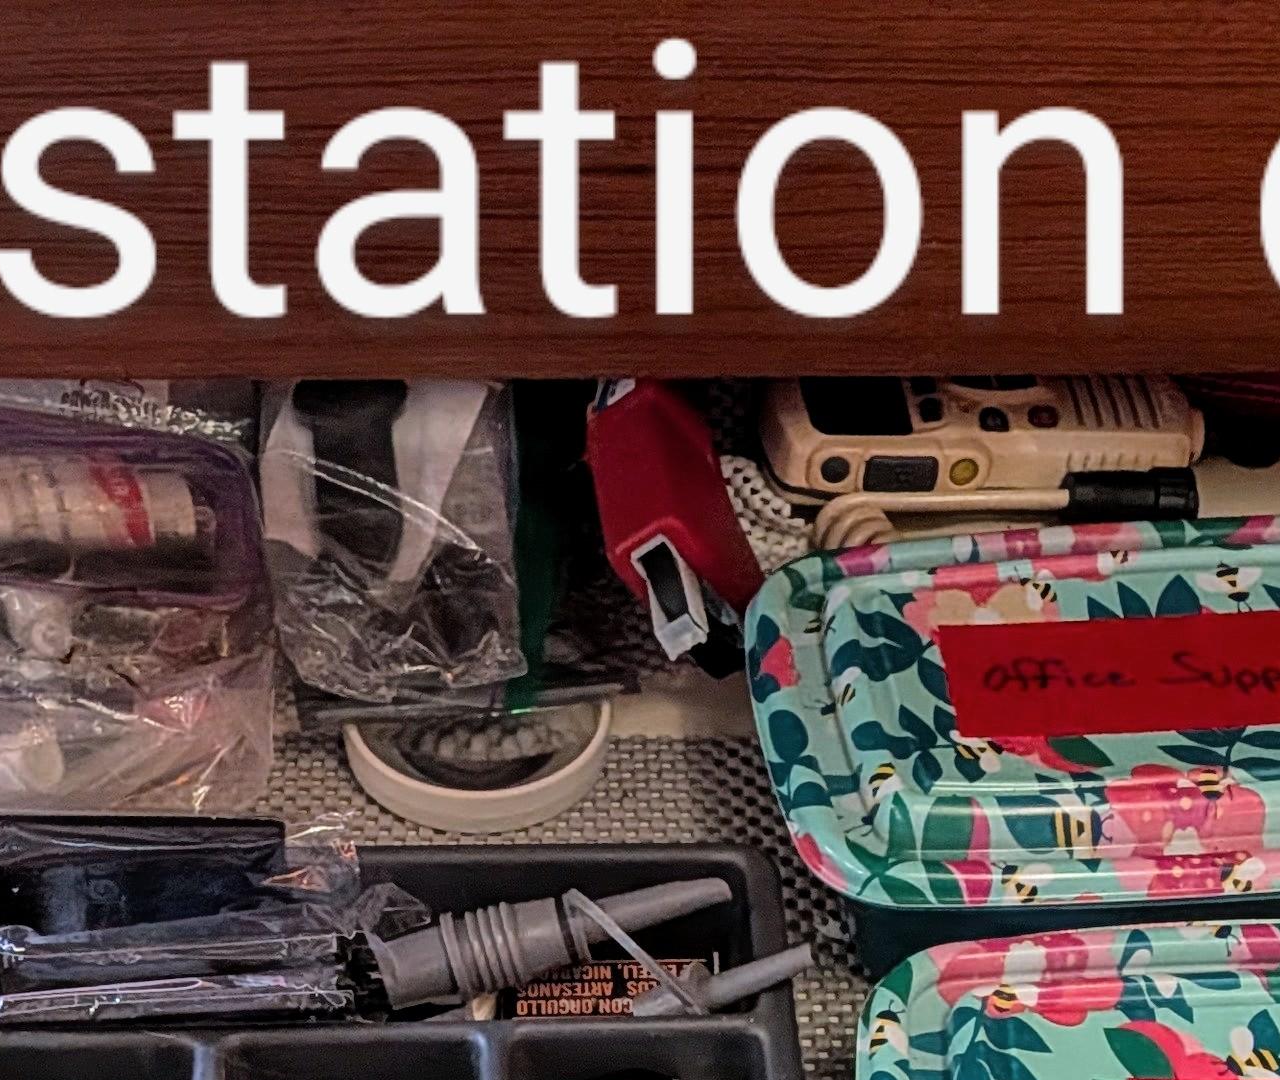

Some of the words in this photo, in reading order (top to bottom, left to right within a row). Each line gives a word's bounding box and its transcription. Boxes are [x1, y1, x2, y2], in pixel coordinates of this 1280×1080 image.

[983, 655, 1135, 691] Office
[516, 999, 593, 1016] ORGULLO
[598, 998, 633, 1014] CON
